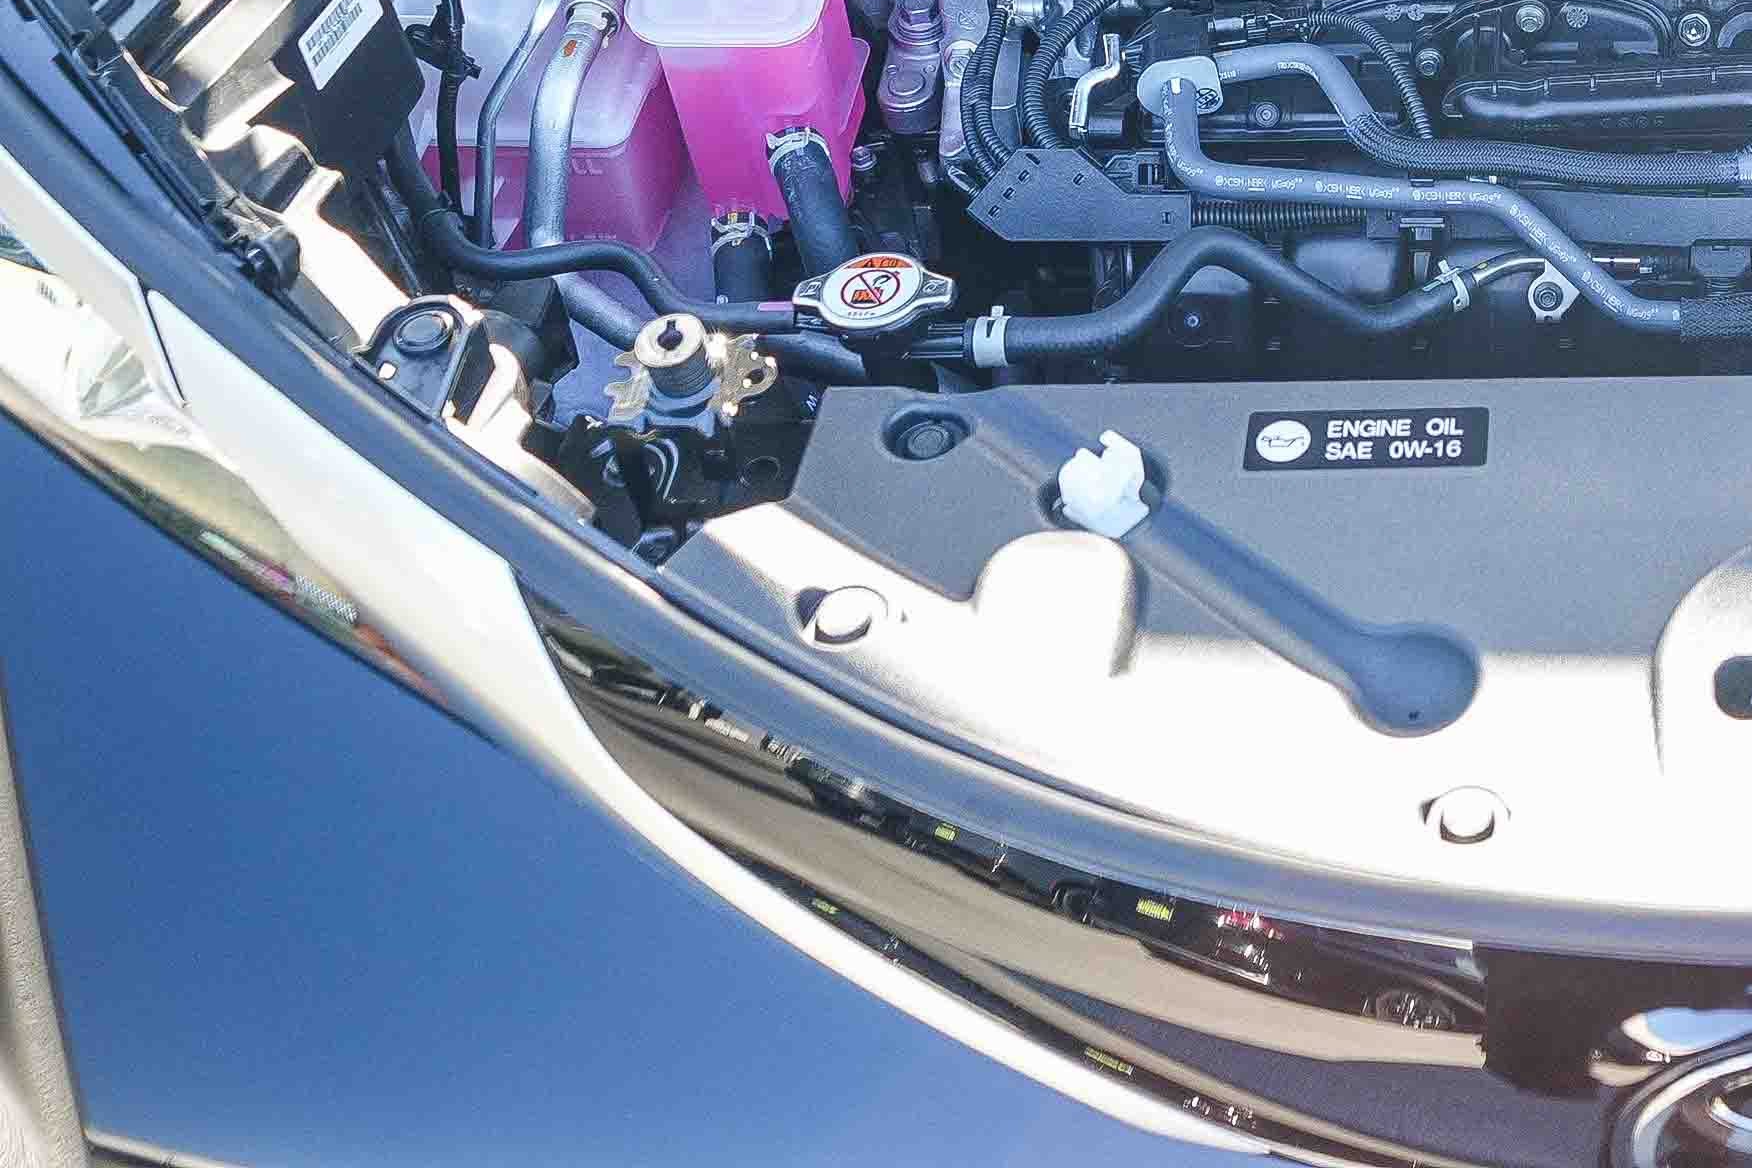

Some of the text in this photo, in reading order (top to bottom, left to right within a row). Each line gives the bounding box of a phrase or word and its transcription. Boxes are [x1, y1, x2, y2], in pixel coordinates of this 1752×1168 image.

[1326, 417, 1464, 439] ENGINE OIL
[1324, 439, 1462, 461] SAE 0W-16
